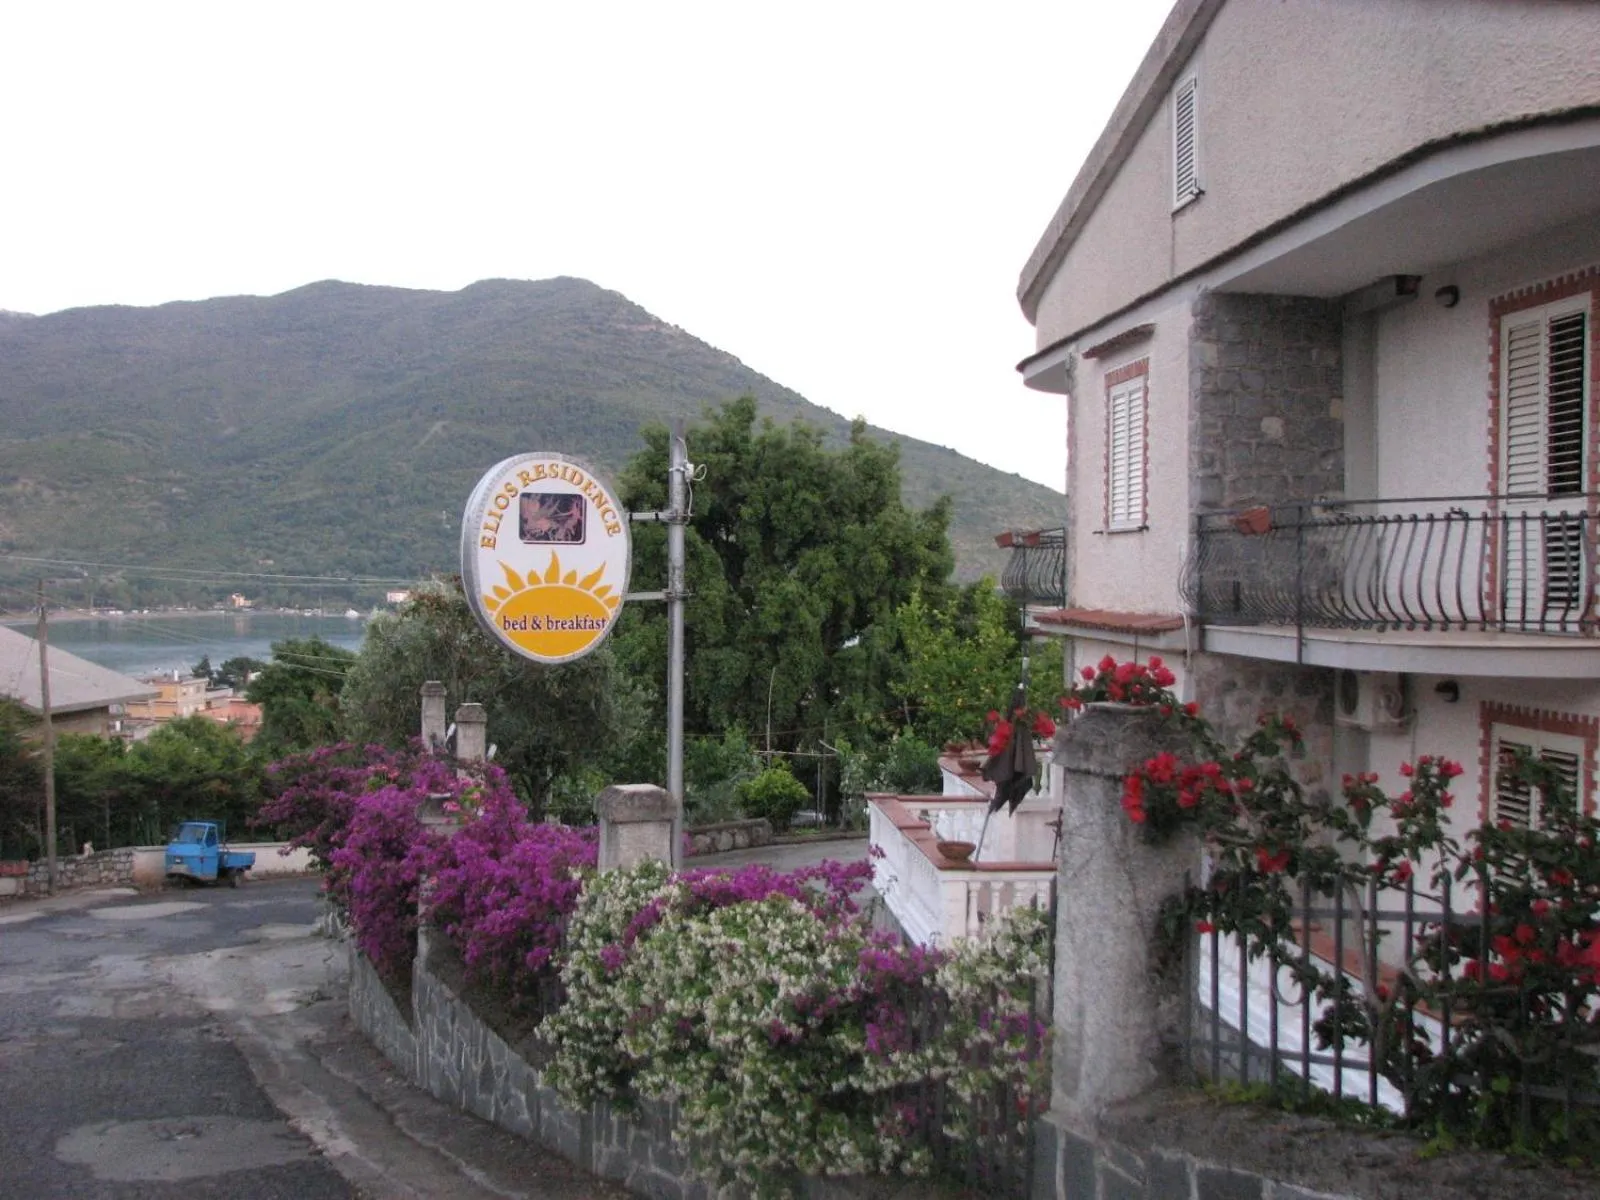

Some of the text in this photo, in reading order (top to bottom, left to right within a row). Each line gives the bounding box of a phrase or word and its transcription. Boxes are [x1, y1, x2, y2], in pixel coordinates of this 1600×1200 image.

[480, 463, 622, 550] ELIOS RESIDENCE
[503, 614, 607, 631] bed & breakfast
